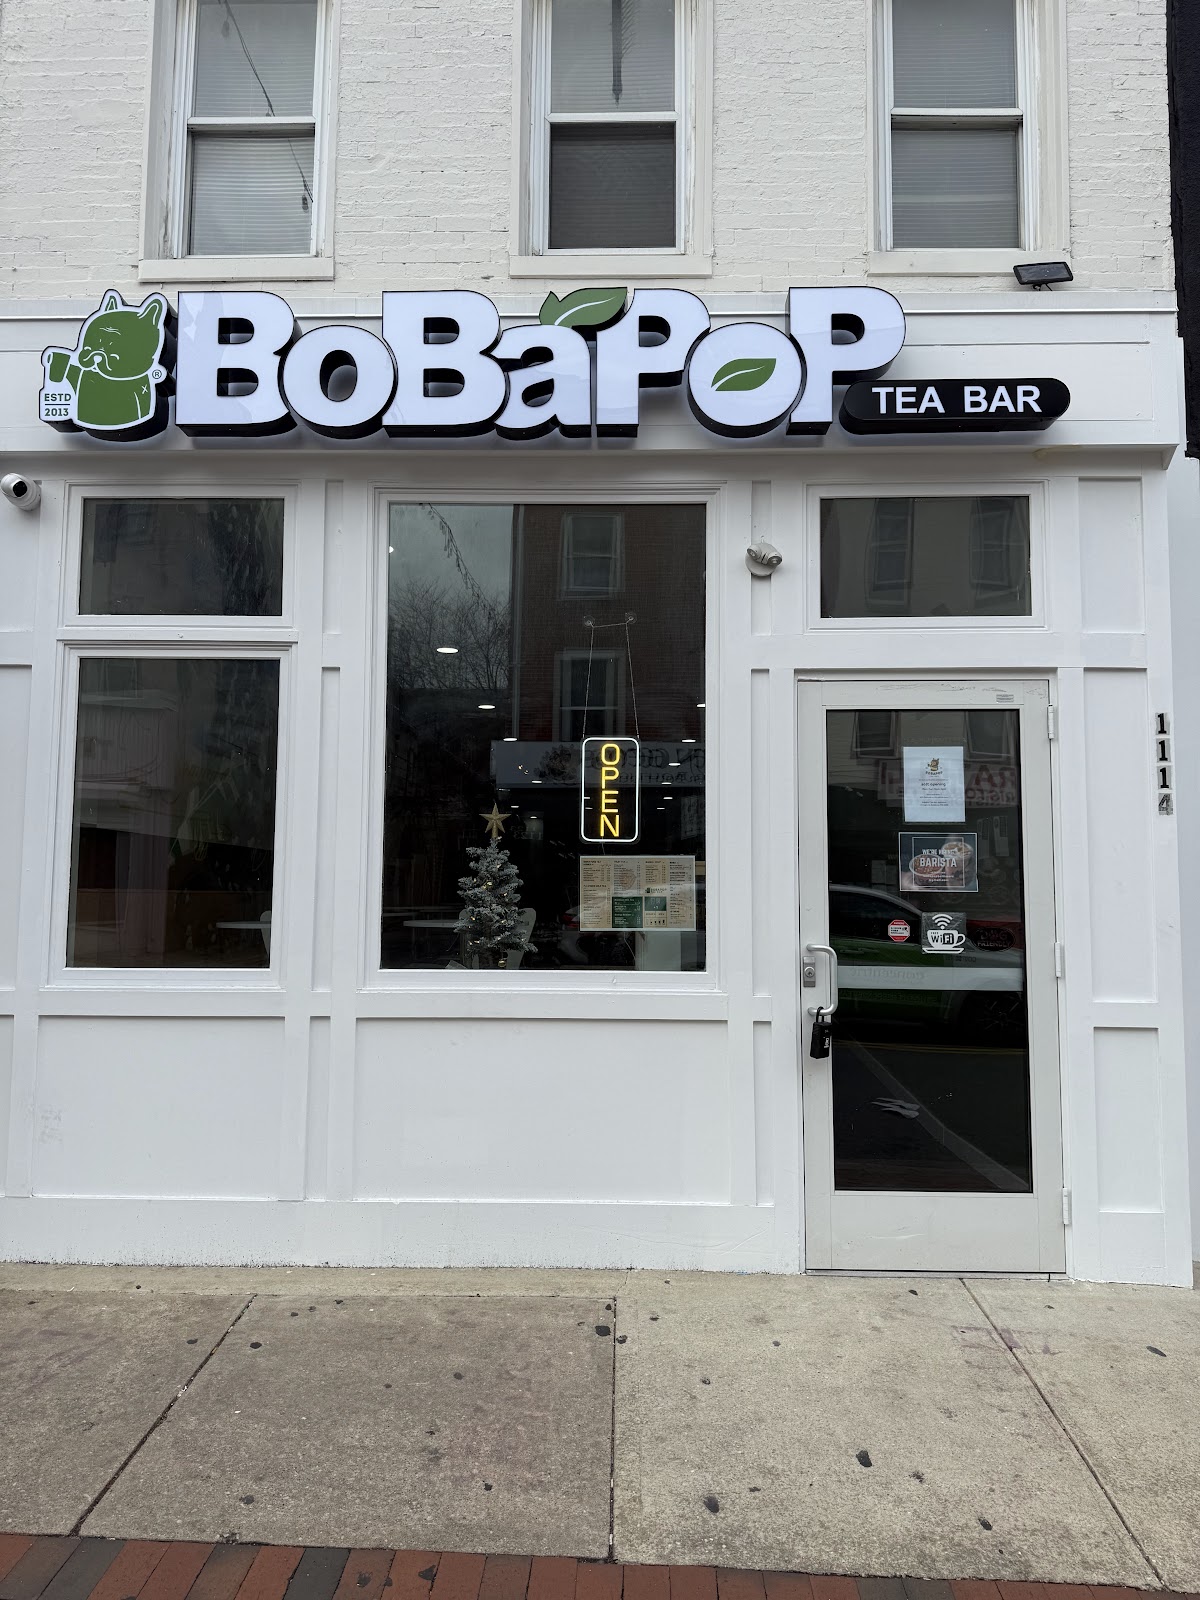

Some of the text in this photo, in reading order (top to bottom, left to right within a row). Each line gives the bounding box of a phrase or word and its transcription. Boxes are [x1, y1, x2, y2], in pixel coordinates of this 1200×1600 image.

[44, 393, 72, 402] ESTD
[872, 385, 1043, 415] TEA BAR
[44, 408, 69, 417] 2013
[1157, 712, 1174, 816] 1114
[600, 743, 621, 837] OPEN
[920, 857, 957, 868] BARISTA
[930, 933, 954, 944] WiFi
